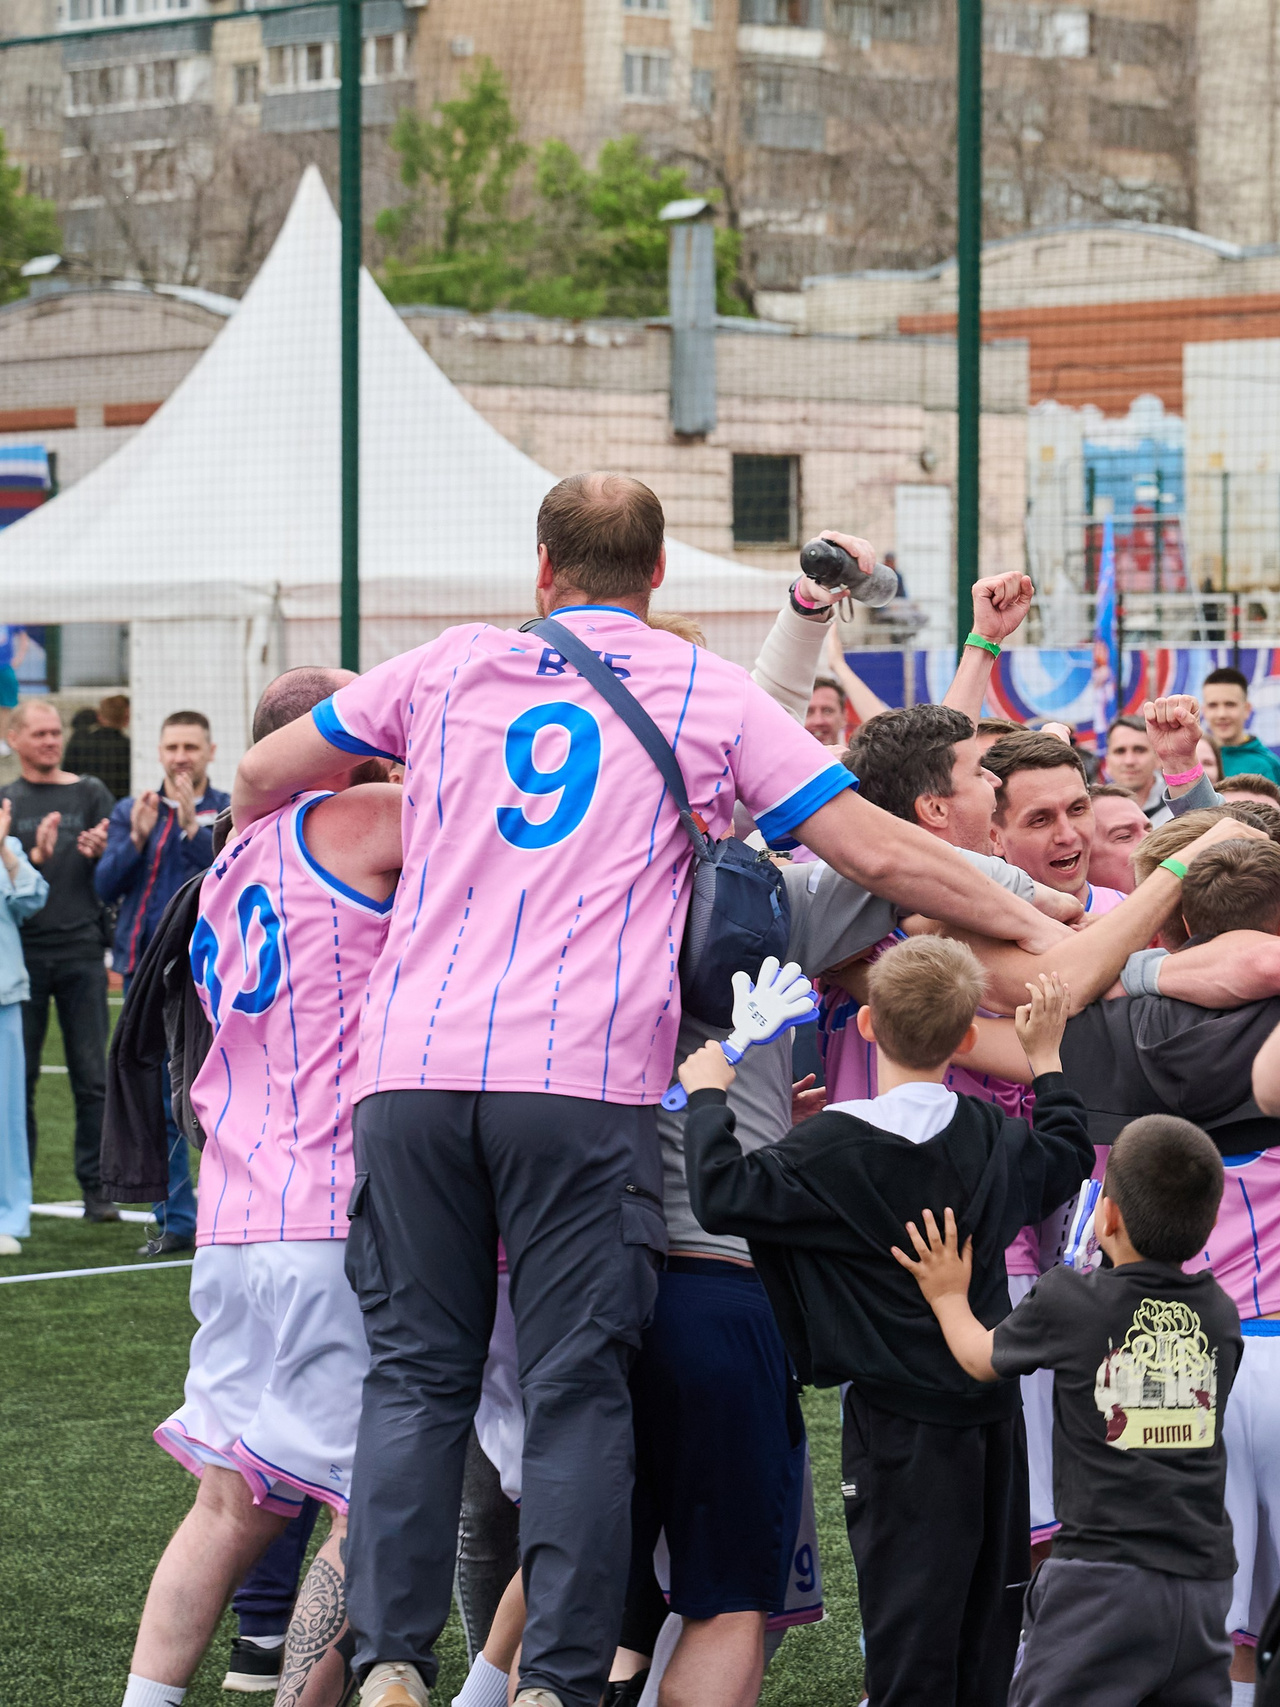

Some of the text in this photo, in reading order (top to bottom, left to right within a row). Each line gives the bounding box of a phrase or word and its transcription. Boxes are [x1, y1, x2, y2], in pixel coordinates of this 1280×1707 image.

[536, 647, 632, 680] ВБ
[495, 699, 604, 852] 9
[1143, 1424, 1192, 1444] PUMA
[794, 1543, 815, 1593] 9
